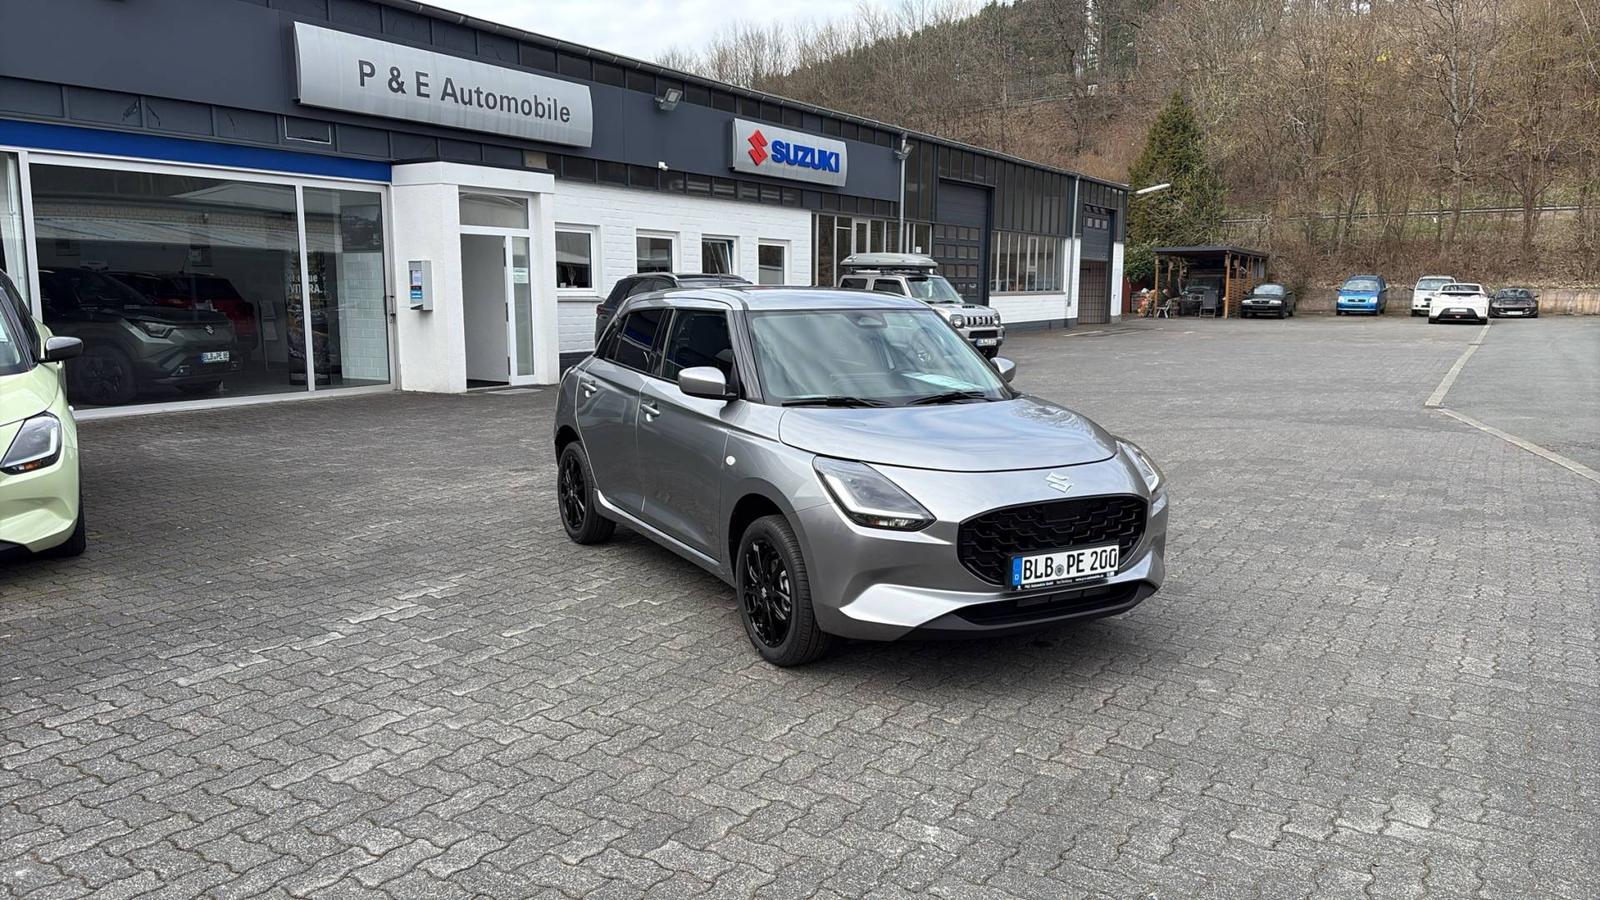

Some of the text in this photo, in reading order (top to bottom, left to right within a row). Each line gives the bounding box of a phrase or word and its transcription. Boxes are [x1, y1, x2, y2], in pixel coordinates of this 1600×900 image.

[358, 60, 571, 123] P & E Automobile
[771, 139, 840, 173] SUZUKI
[1023, 548, 1117, 580] BLB PE 200
